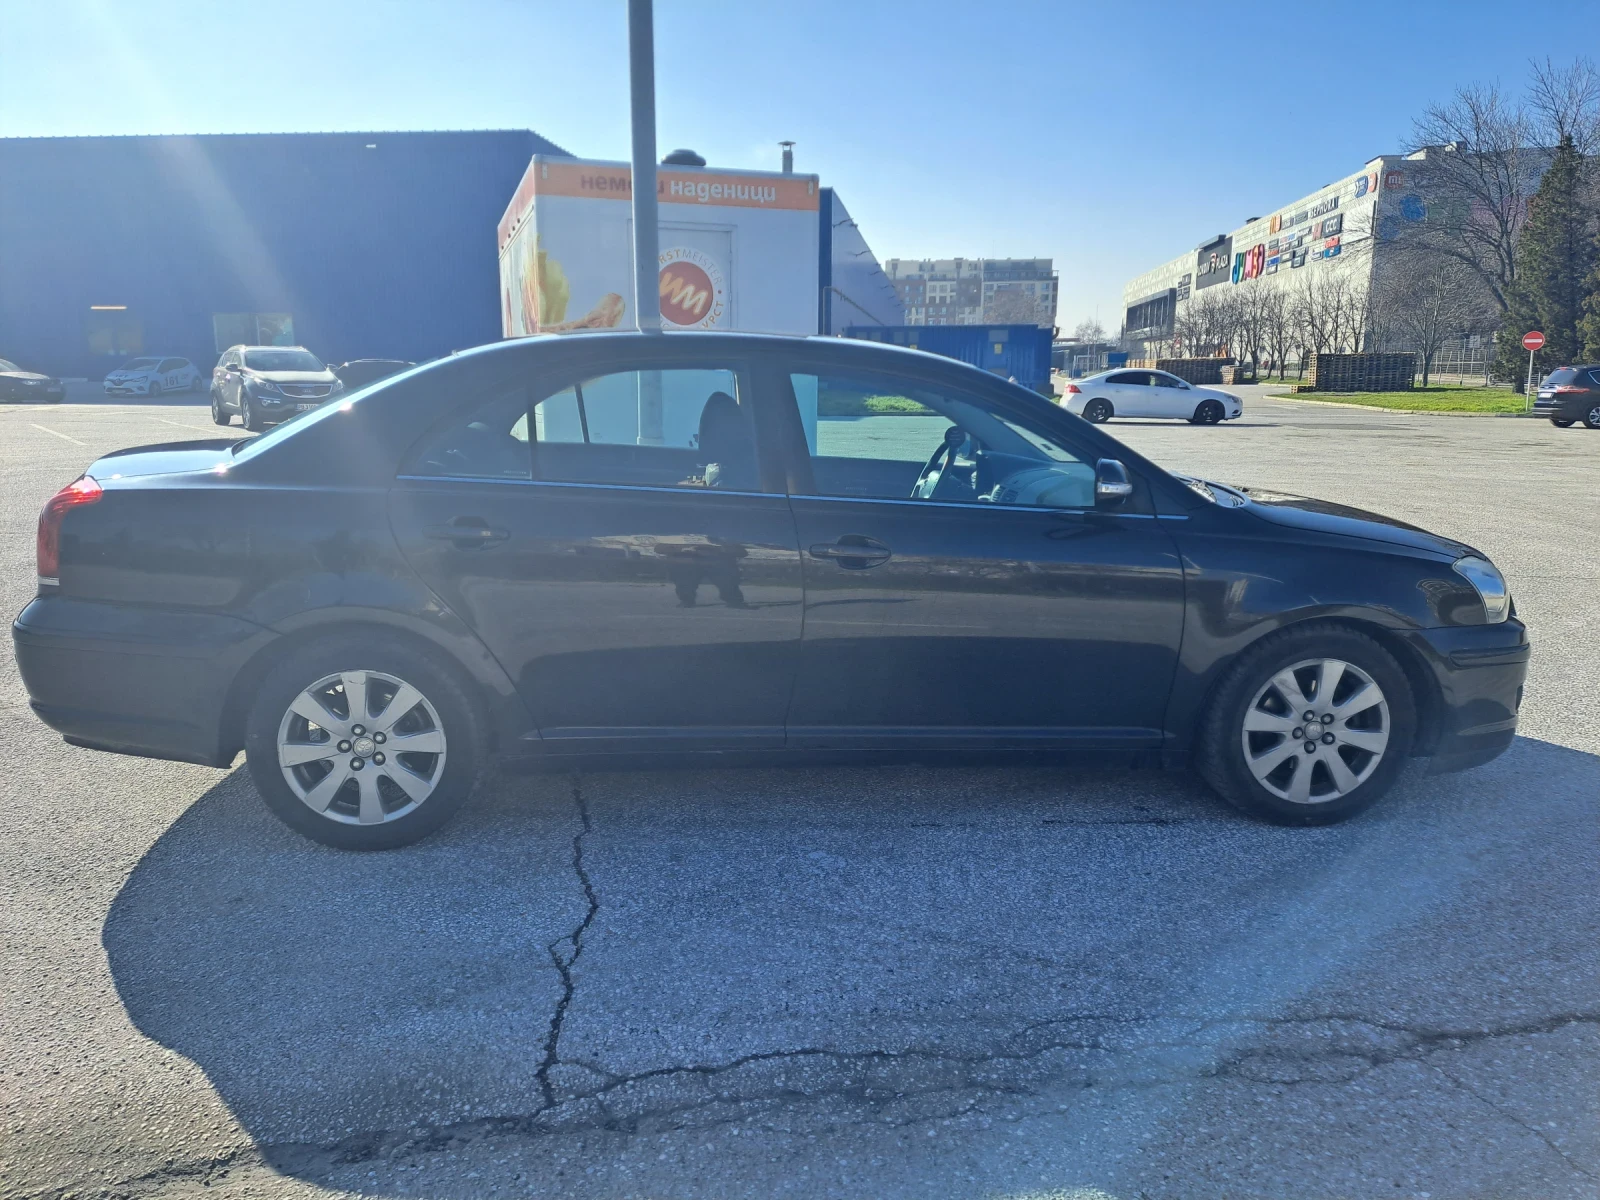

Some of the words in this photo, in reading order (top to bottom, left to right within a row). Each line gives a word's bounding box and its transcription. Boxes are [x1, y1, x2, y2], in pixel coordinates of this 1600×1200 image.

[581, 175, 664, 194] неми
[670, 180, 776, 203] наденици
[1325, 218, 1338, 233] CCC
[659, 248, 722, 285] RSTMEISTER
[1232, 243, 1265, 285] JUMBO
[164, 376, 179, 387] 161
